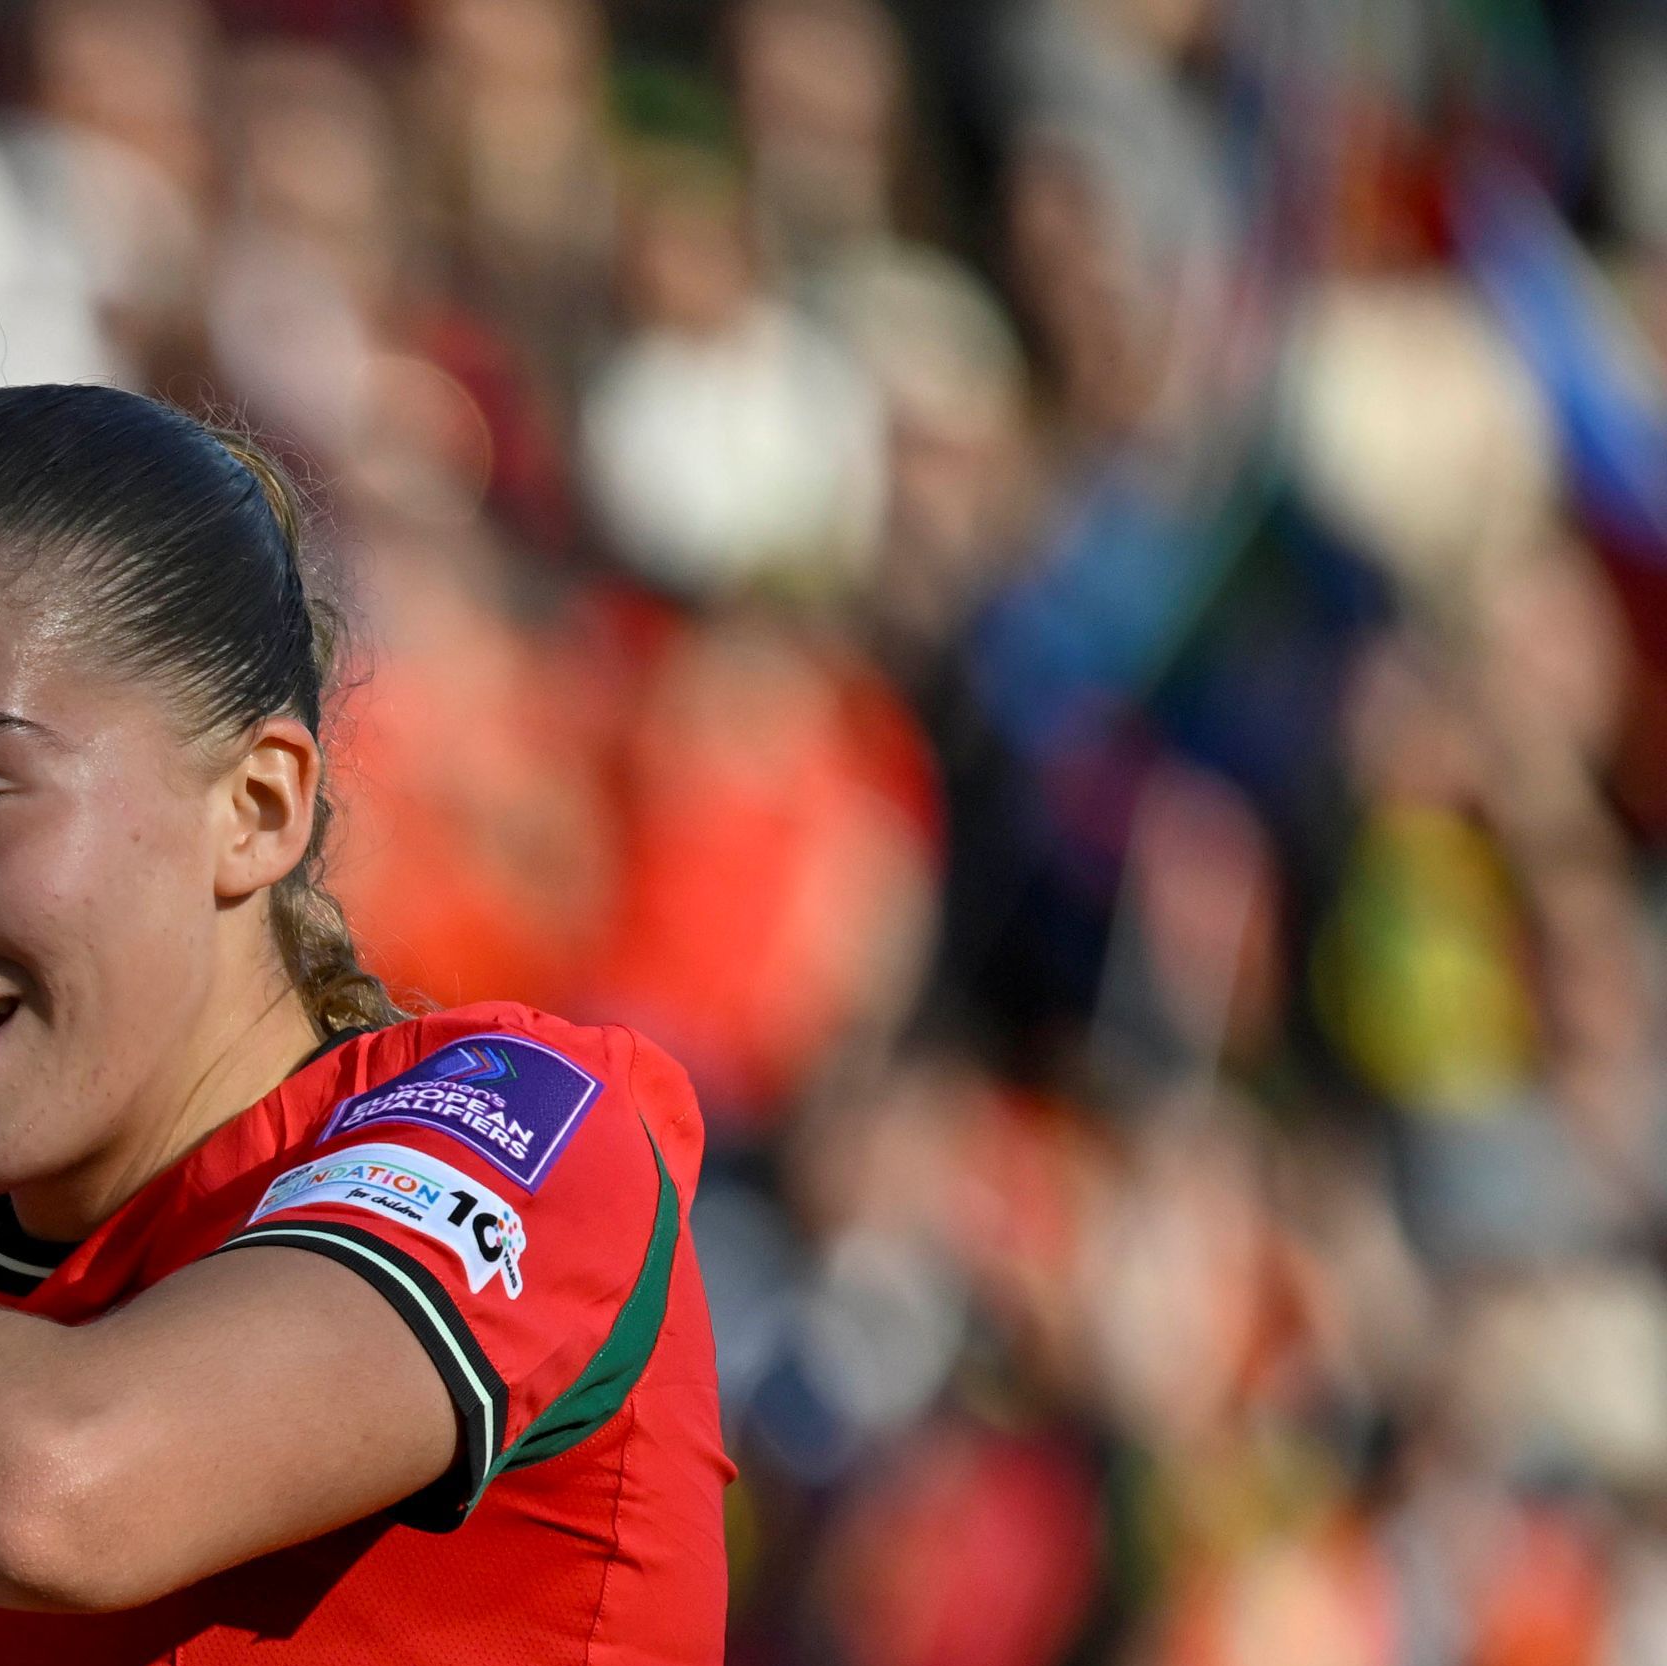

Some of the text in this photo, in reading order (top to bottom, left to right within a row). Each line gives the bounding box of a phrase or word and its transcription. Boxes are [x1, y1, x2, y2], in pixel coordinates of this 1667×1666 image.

[354, 1088, 535, 1145] EUROPEAN
[396, 1080, 506, 1108] women's
[341, 1098, 529, 1160] QUALIFIERS
[345, 1188, 424, 1222] for children
